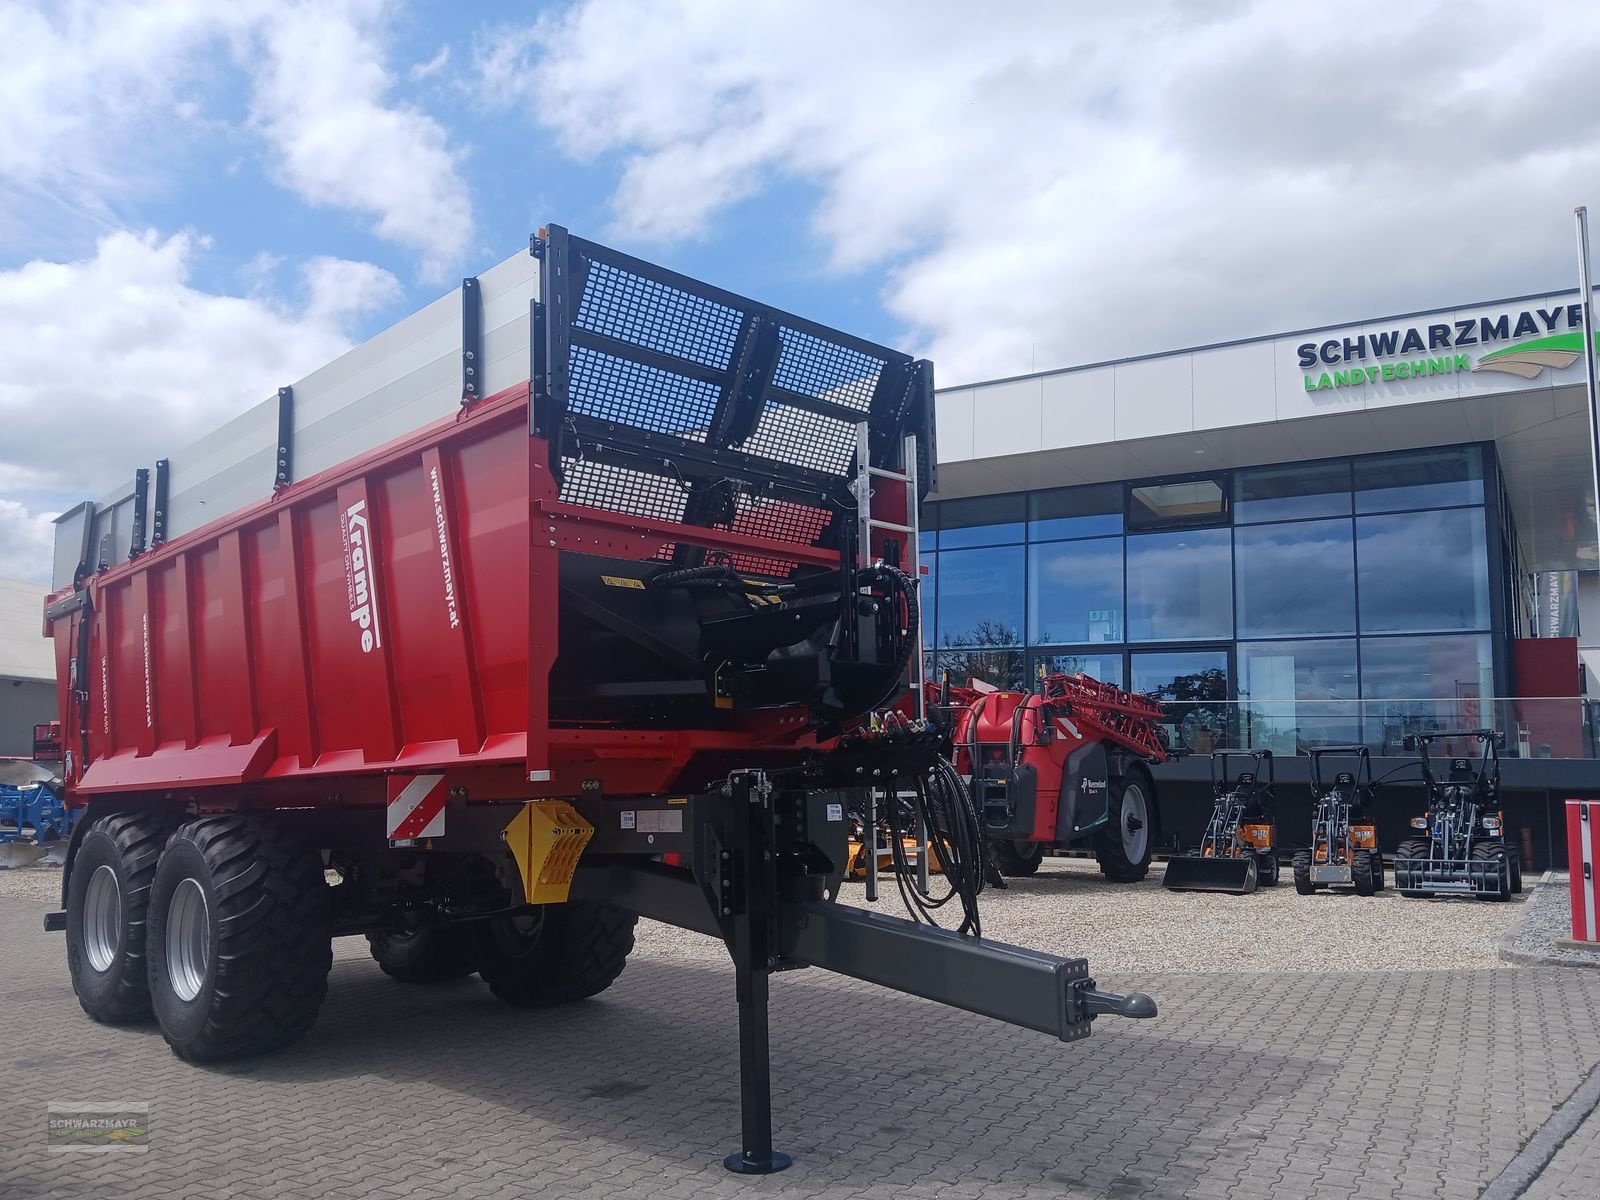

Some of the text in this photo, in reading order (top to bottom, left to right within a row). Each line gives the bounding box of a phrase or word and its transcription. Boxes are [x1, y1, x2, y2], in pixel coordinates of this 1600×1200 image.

[1297, 303, 1584, 368] SCHWARZMAYR
[1304, 353, 1471, 392] LANDTECHNIK
[340, 513, 355, 611] QUALITY ON WHEELS
[347, 499, 380, 654] Krampe
[430, 466, 460, 629] www.schwarzmayr.at
